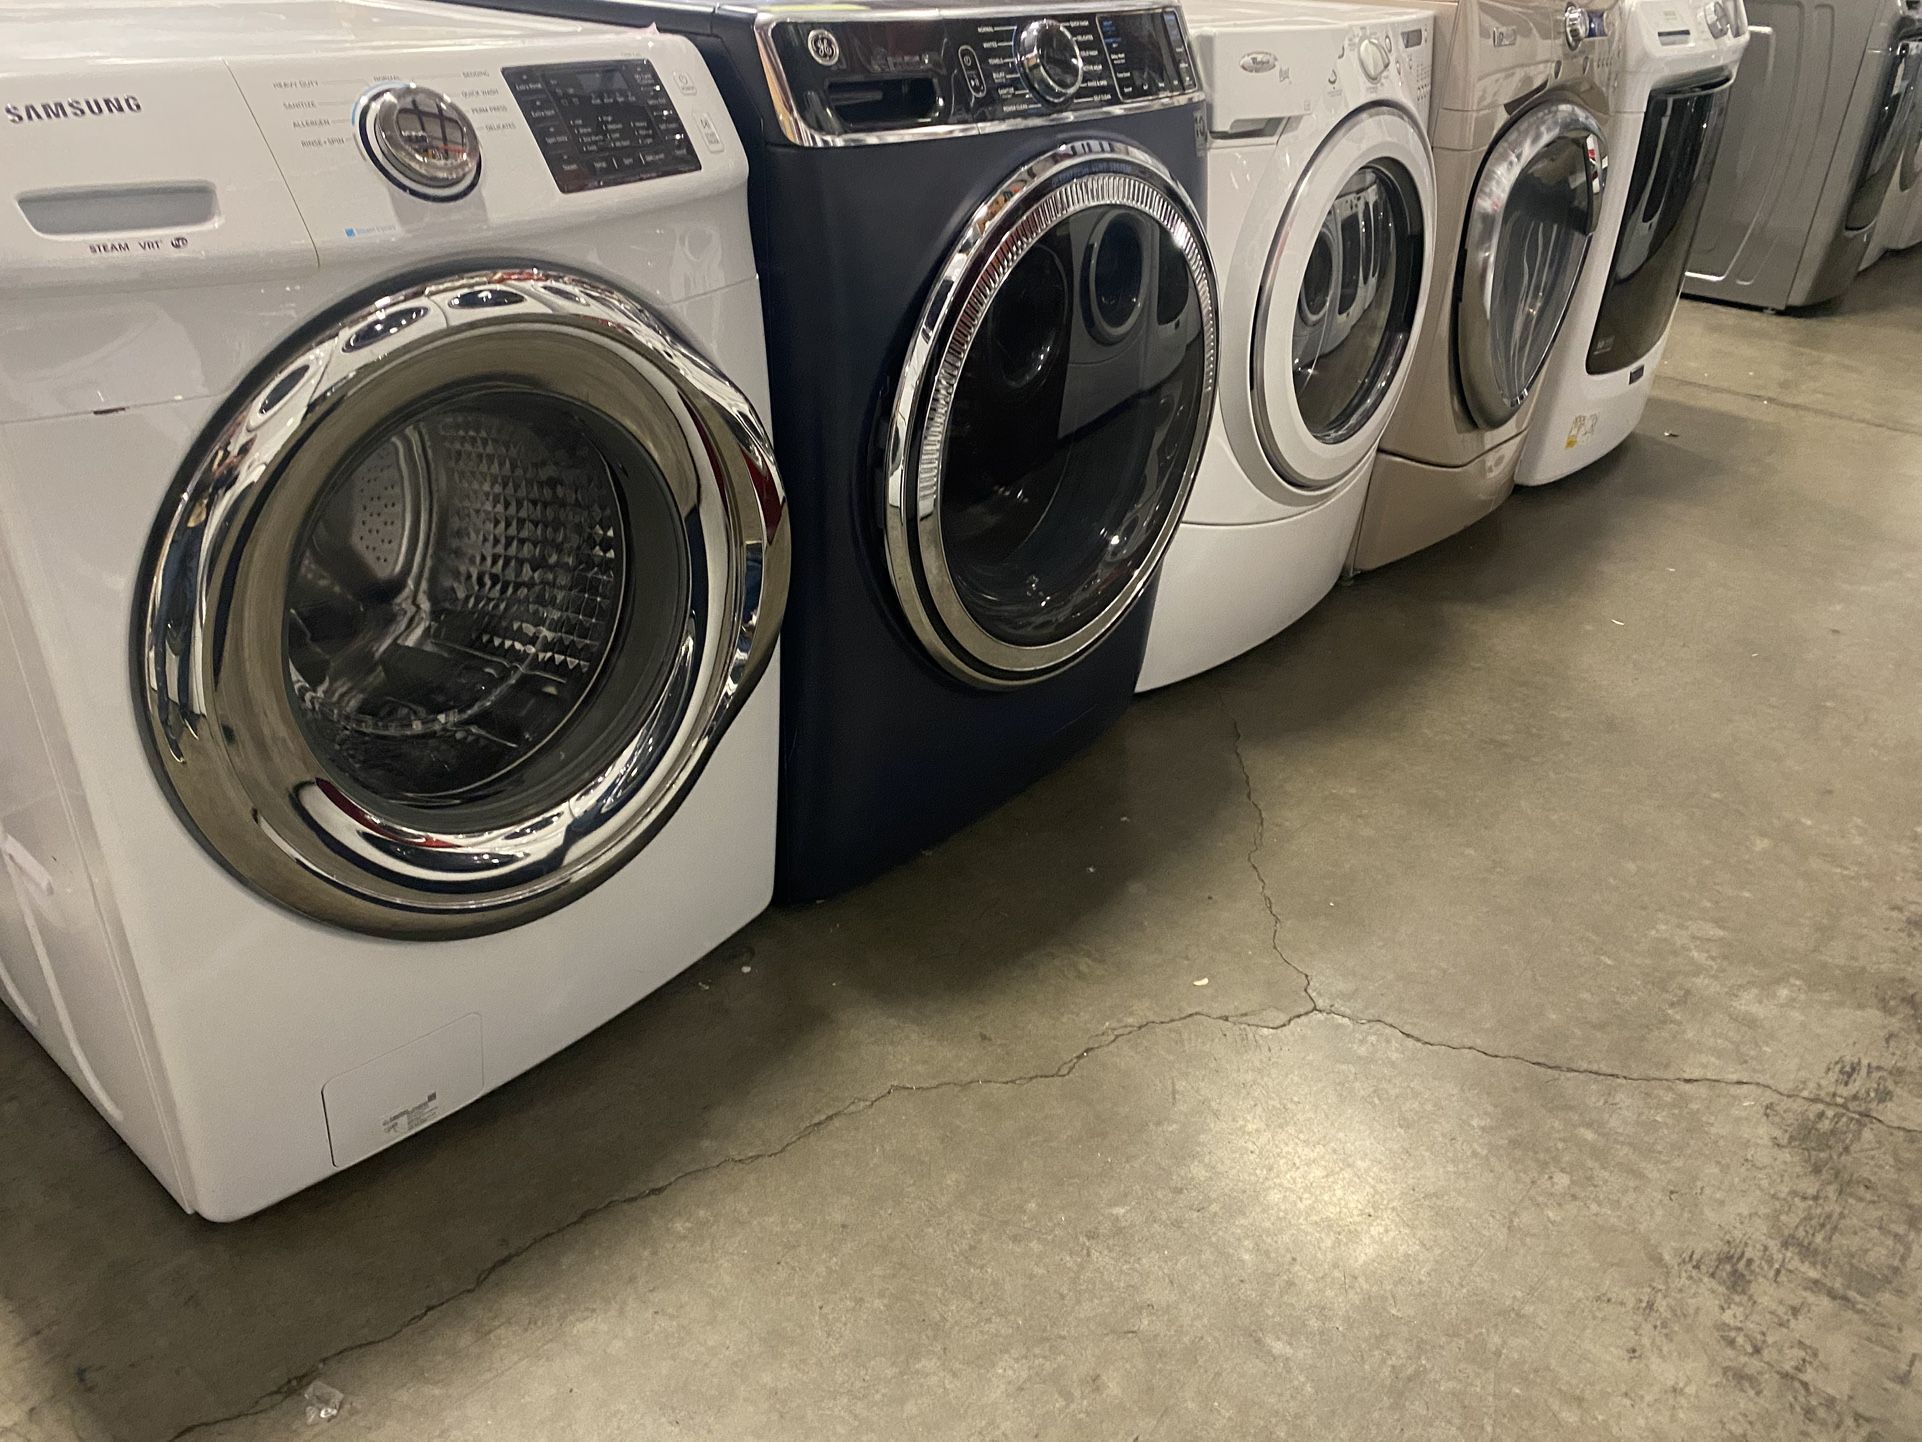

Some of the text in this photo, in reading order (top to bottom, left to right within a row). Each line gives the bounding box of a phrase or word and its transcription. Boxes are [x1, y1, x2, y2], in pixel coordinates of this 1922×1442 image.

[4, 96, 143, 125] SAMSUNG
[292, 118, 331, 128] ALLERGEN
[89, 240, 131, 254] STEAM
